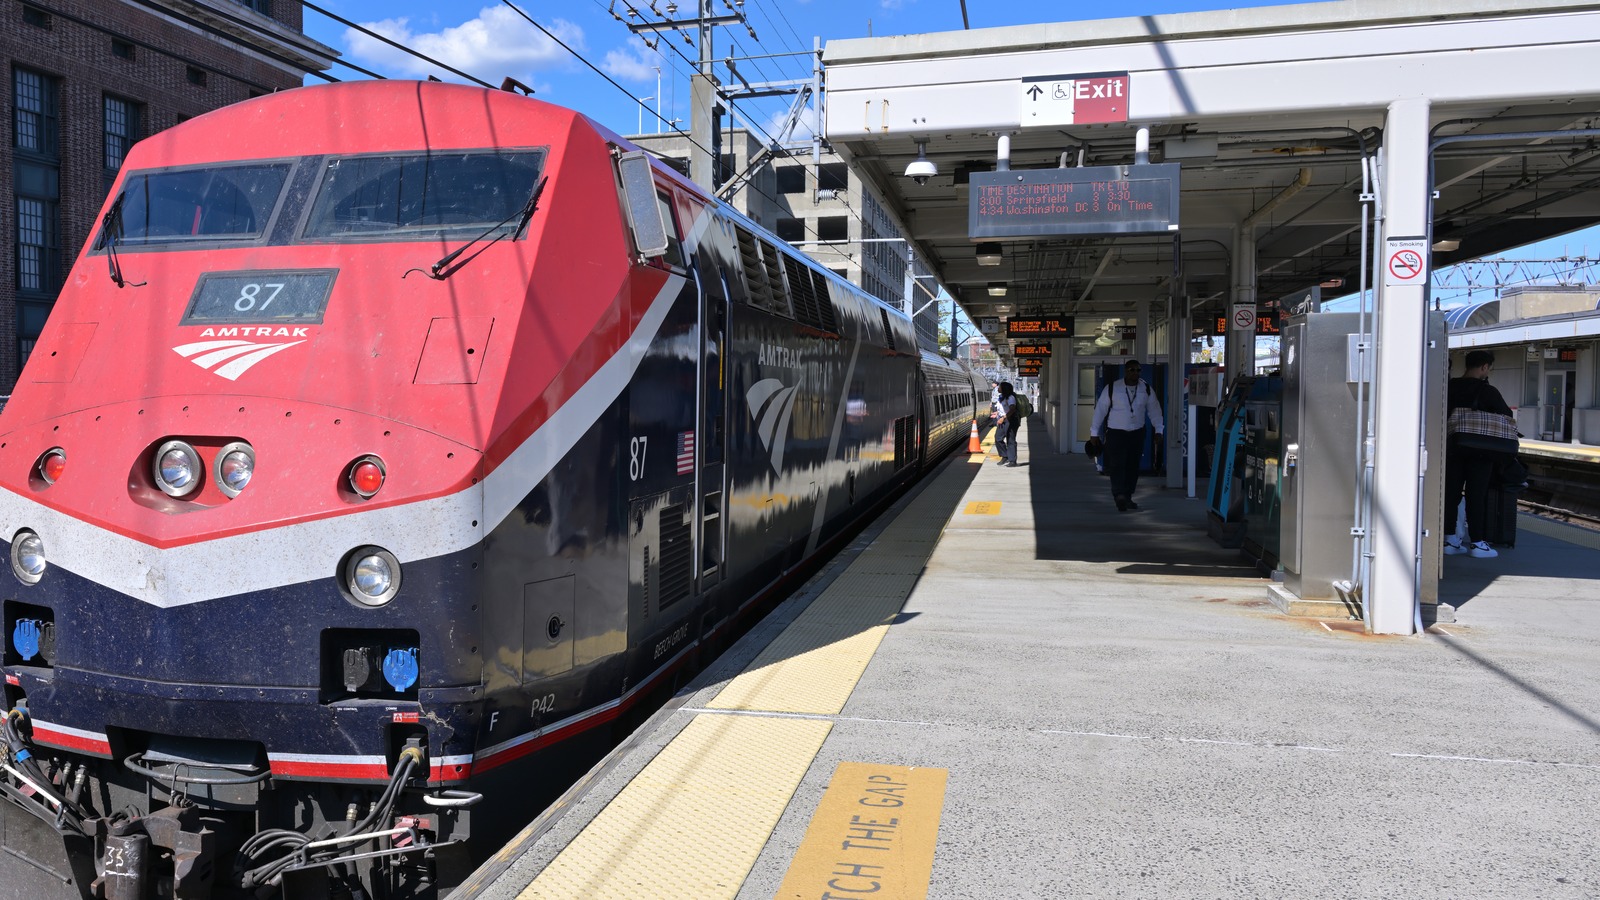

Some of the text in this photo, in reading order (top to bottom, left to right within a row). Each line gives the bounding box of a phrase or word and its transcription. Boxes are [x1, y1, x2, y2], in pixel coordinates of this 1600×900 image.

[1075, 79, 1123, 99] Exit
[980, 181, 1130, 196] TIME DESTINATION TK ETD
[980, 191, 1131, 206] 3:00 Springfield 3 3:30
[980, 200, 1153, 216] 4:34 Washington DC 3 On Time
[234, 283, 285, 312] 87
[199, 327, 309, 337] AMTRAK
[758, 343, 802, 370] AMTRAK
[629, 436, 648, 482] 87
[530, 693, 555, 718] P42
[489, 711, 499, 732] F
[858, 775, 908, 808] GAP
[841, 815, 899, 850] THE
[105, 845, 124, 867] 33
